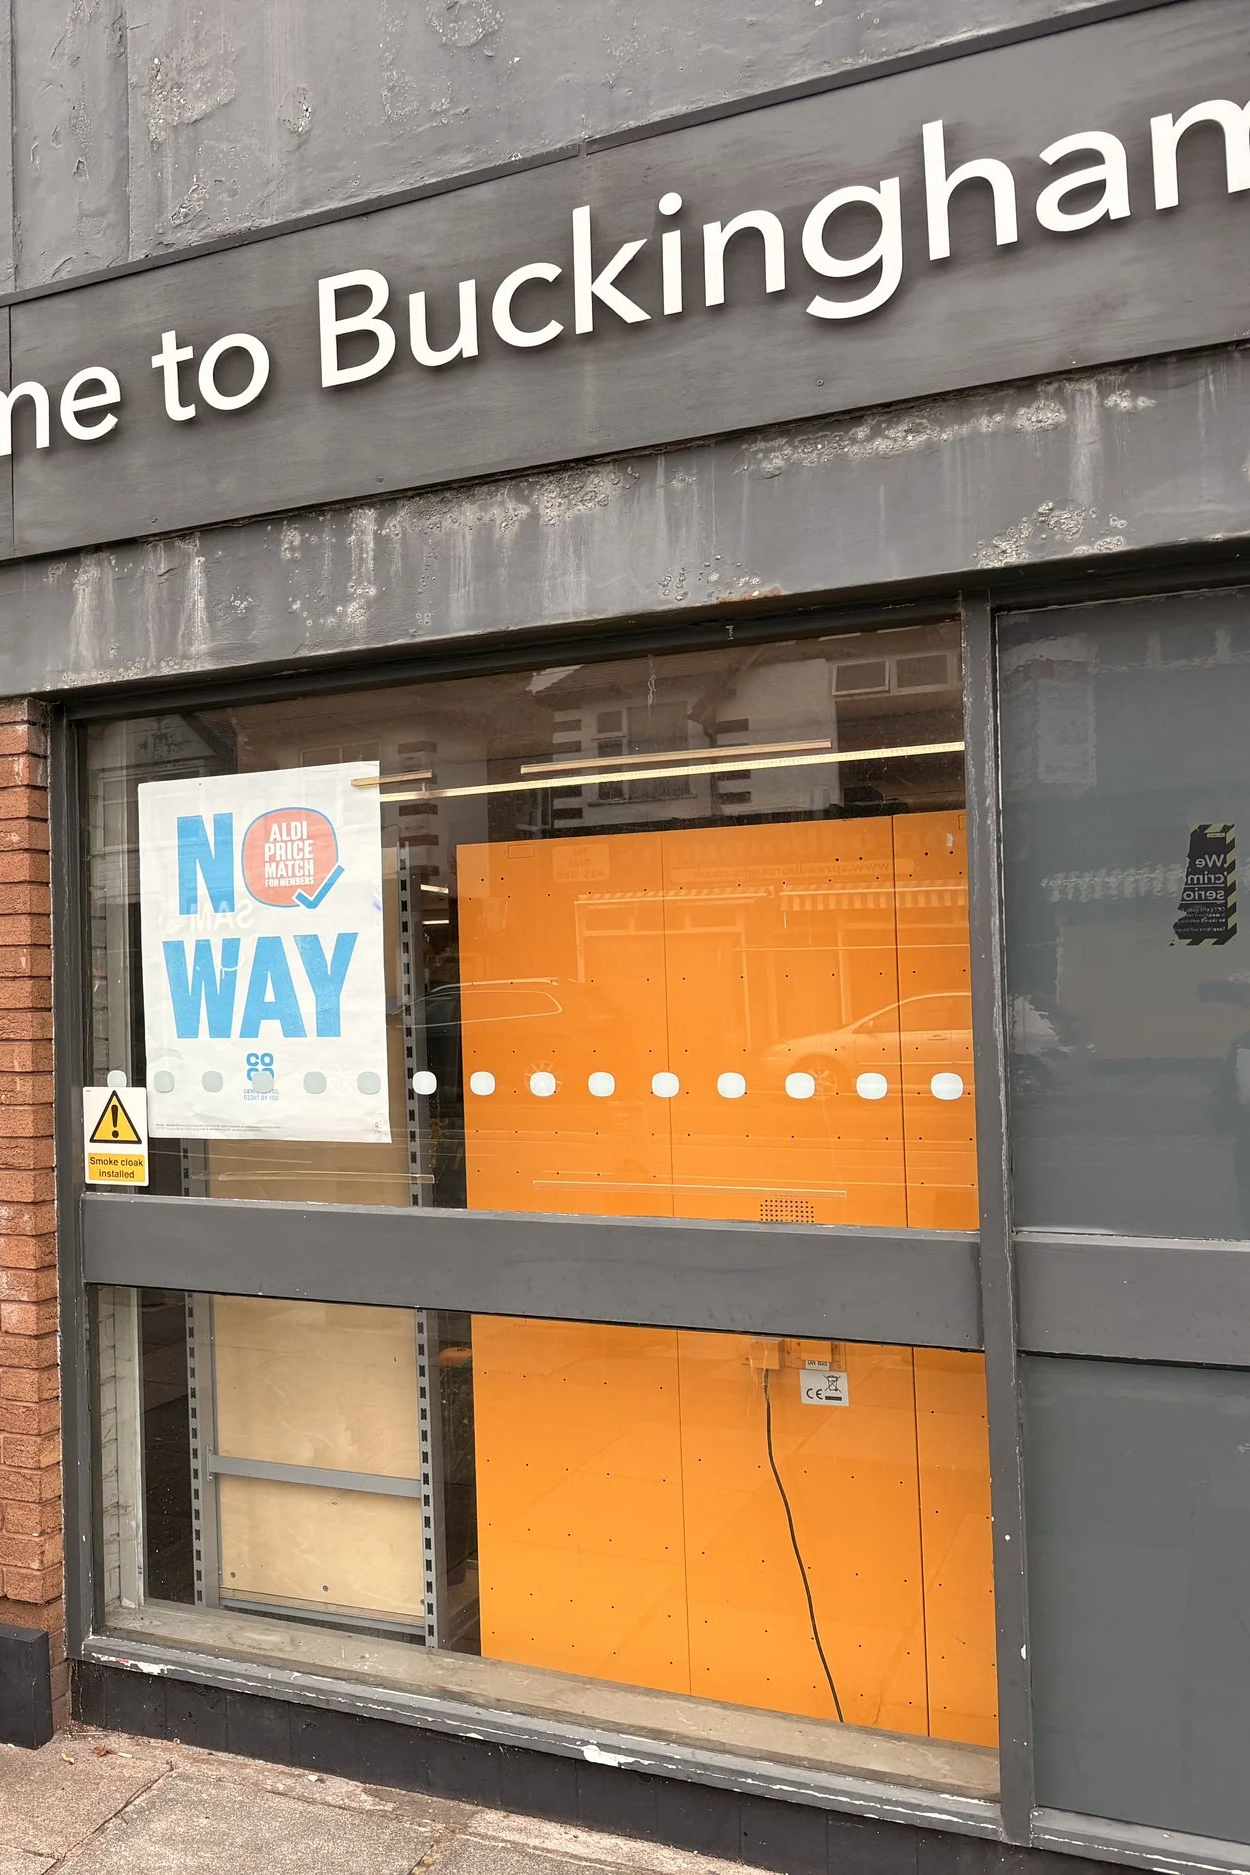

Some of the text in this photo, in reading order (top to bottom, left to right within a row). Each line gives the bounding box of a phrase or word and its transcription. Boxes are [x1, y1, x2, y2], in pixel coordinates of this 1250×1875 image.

[151, 329, 271, 422] to
[268, 820, 308, 843] ALDI
[263, 839, 314, 861] PRICE
[264, 857, 315, 879] MATCH
[265, 875, 315, 887] FOR MEMBERS
[162, 932, 358, 1039] WAY
[89, 1156, 144, 1167] Smoke cloak
[98, 1169, 135, 1179] installed
